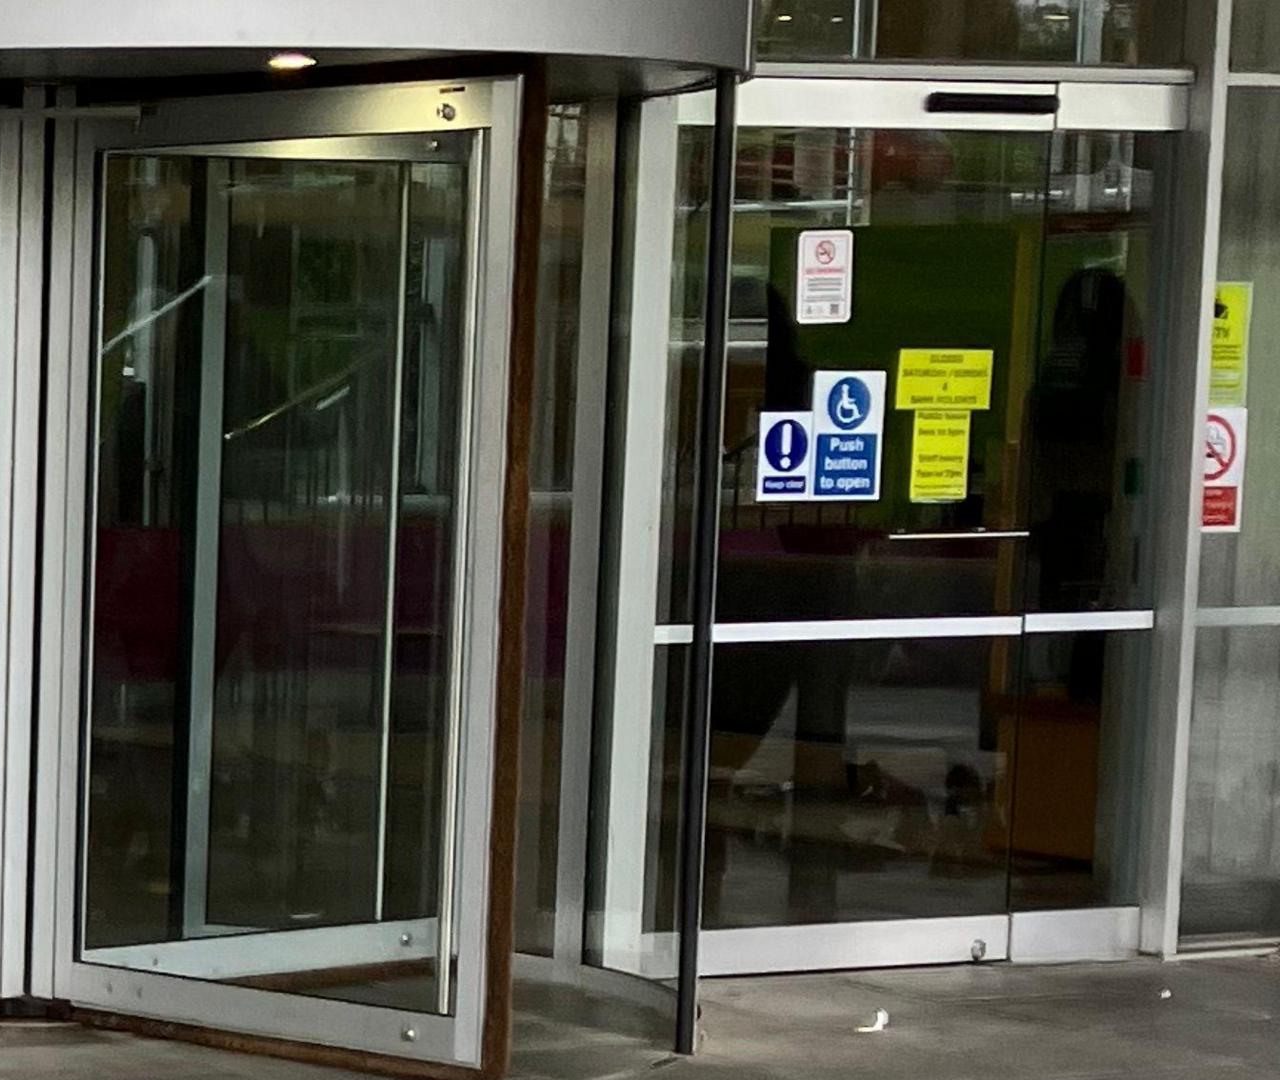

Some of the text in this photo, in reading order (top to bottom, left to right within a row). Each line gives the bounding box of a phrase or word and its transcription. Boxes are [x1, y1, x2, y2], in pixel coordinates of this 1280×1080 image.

[830, 437, 865, 452] Push
[824, 457, 868, 471] button
[820, 474, 870, 492] to open
